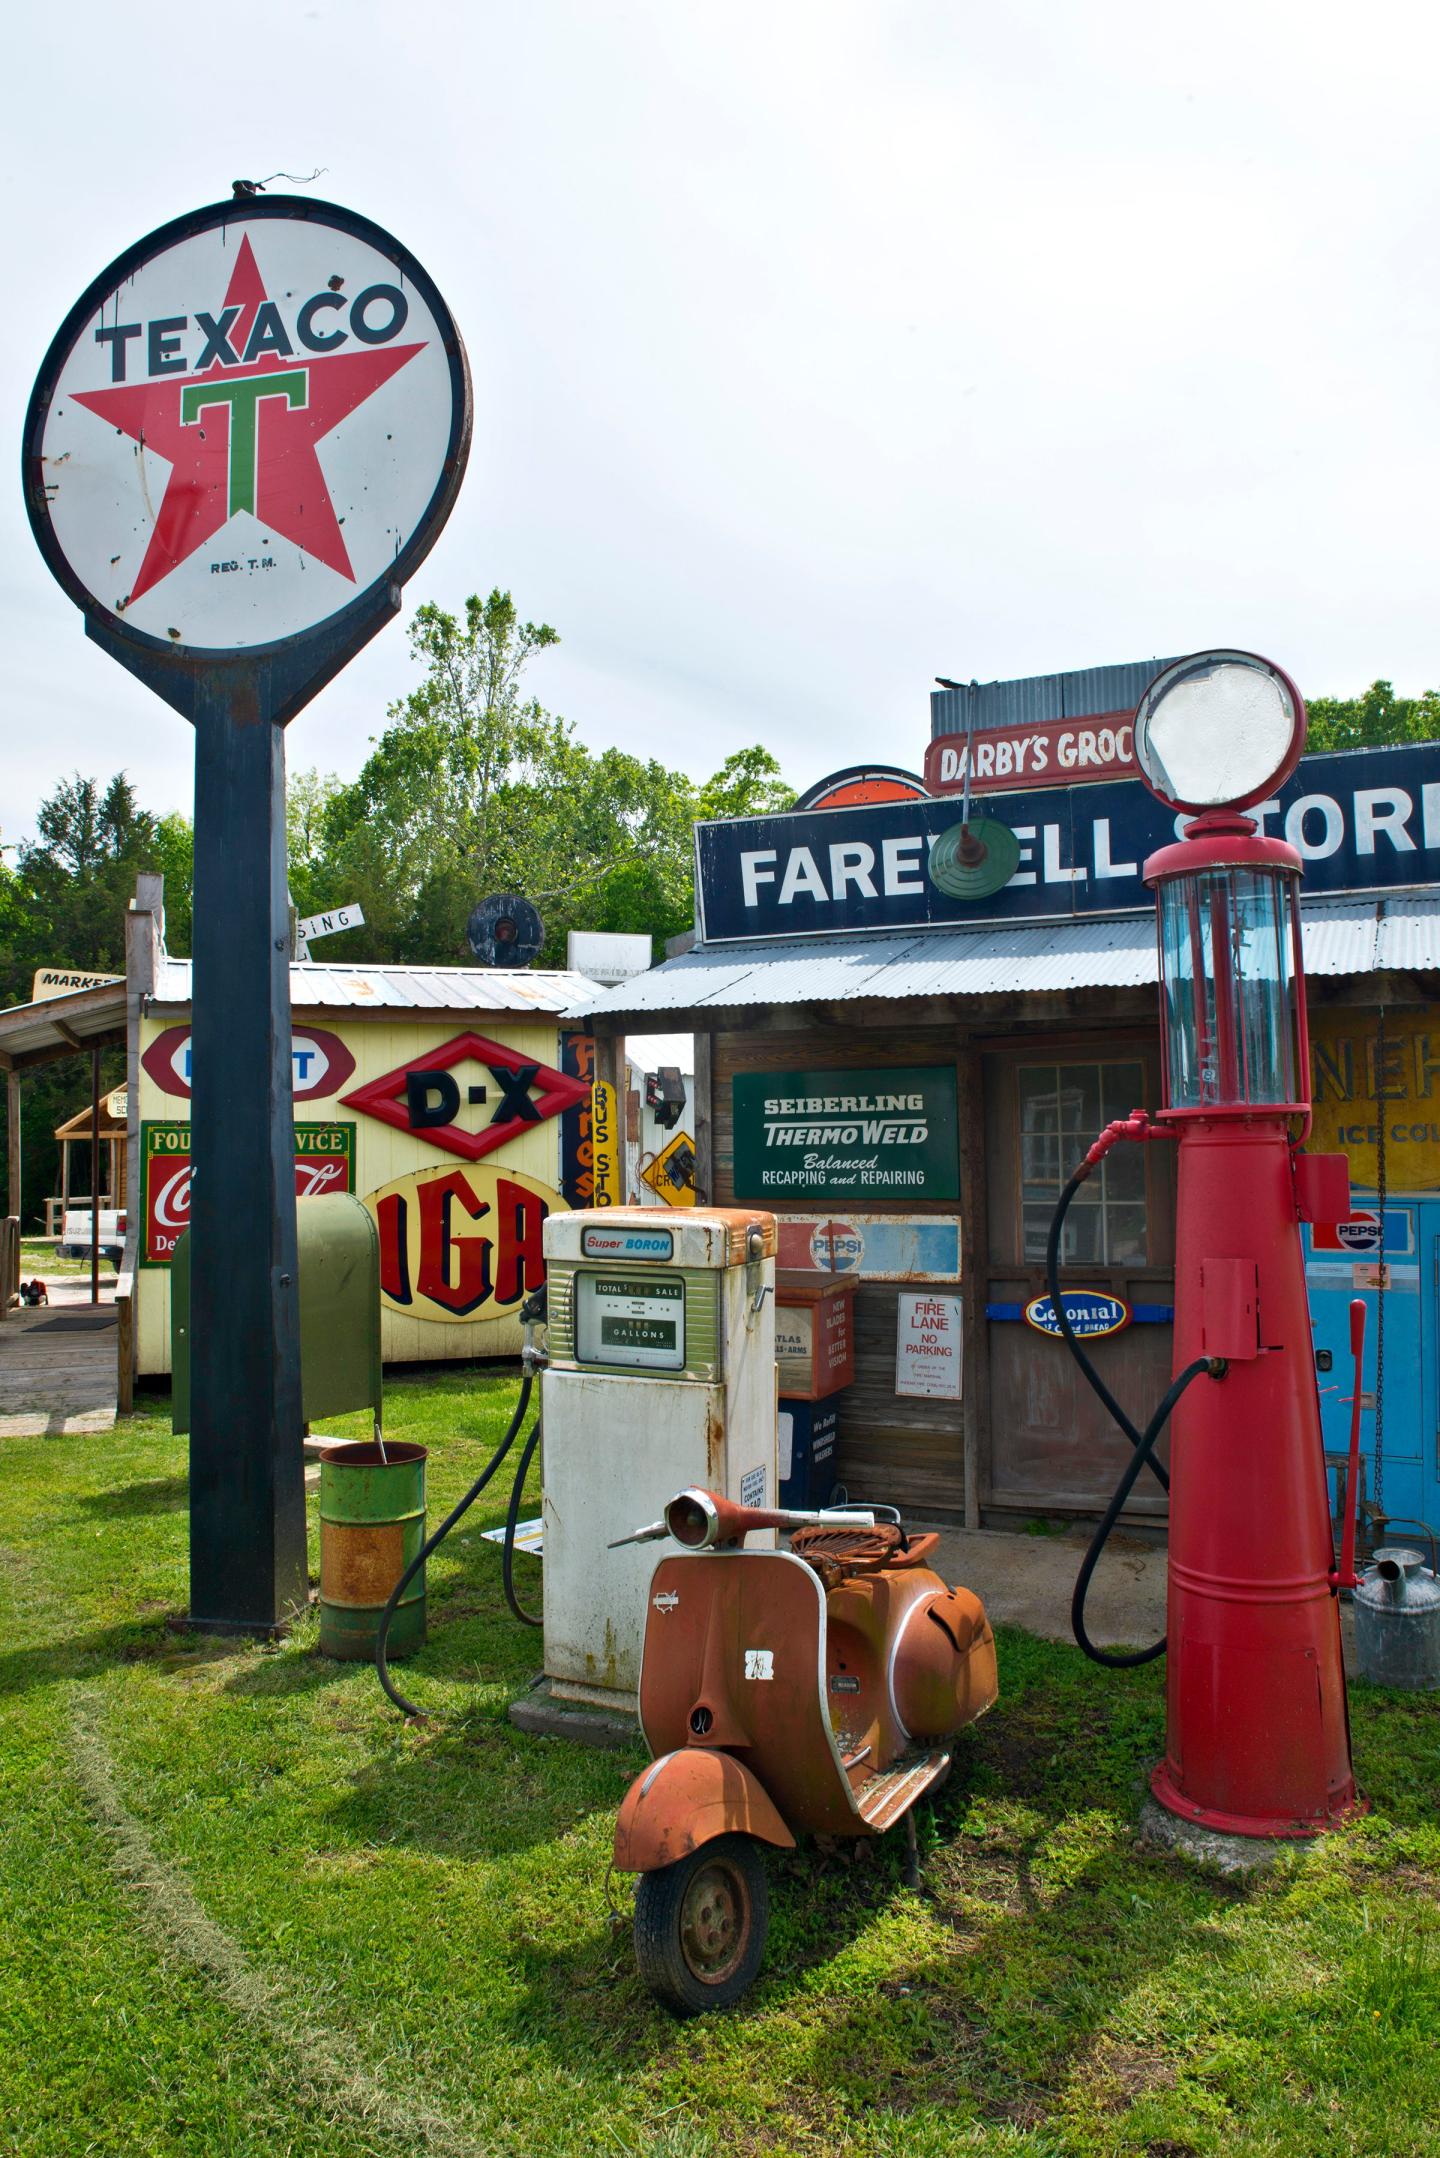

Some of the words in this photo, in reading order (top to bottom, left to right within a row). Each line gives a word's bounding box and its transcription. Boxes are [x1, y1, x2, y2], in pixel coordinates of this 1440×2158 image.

[95, 283, 409, 383] TEXACO
[940, 735, 1049, 782] DARBY'S
[740, 818, 1138, 907] FAREELL
[42, 973, 112, 989] MARKE
[764, 1094, 924, 1115] SEIBERLING
[803, 1152, 878, 1170] Balanced
[762, 1170, 826, 1185] RECAPPING
[829, 1173, 856, 1185] and
[861, 1170, 925, 1185] REPAIRING
[376, 1169, 548, 1316] IGA
[587, 1236, 623, 1249] Super
[625, 1238, 670, 1251] BORON
[813, 1240, 862, 1253] PEPSI
[598, 1284, 622, 1293] TOTAL
[655, 1288, 679, 1296] SALE
[915, 1302, 946, 1316] FIRE
[1029, 1302, 1118, 1322] Coonial
[911, 1315, 949, 1331] LANE
[613, 1328, 664, 1339] GALLONS
[775, 1335, 801, 1344] TLAS
[921, 1333, 938, 1343] NO
[905, 1344, 953, 1357] PARKING
